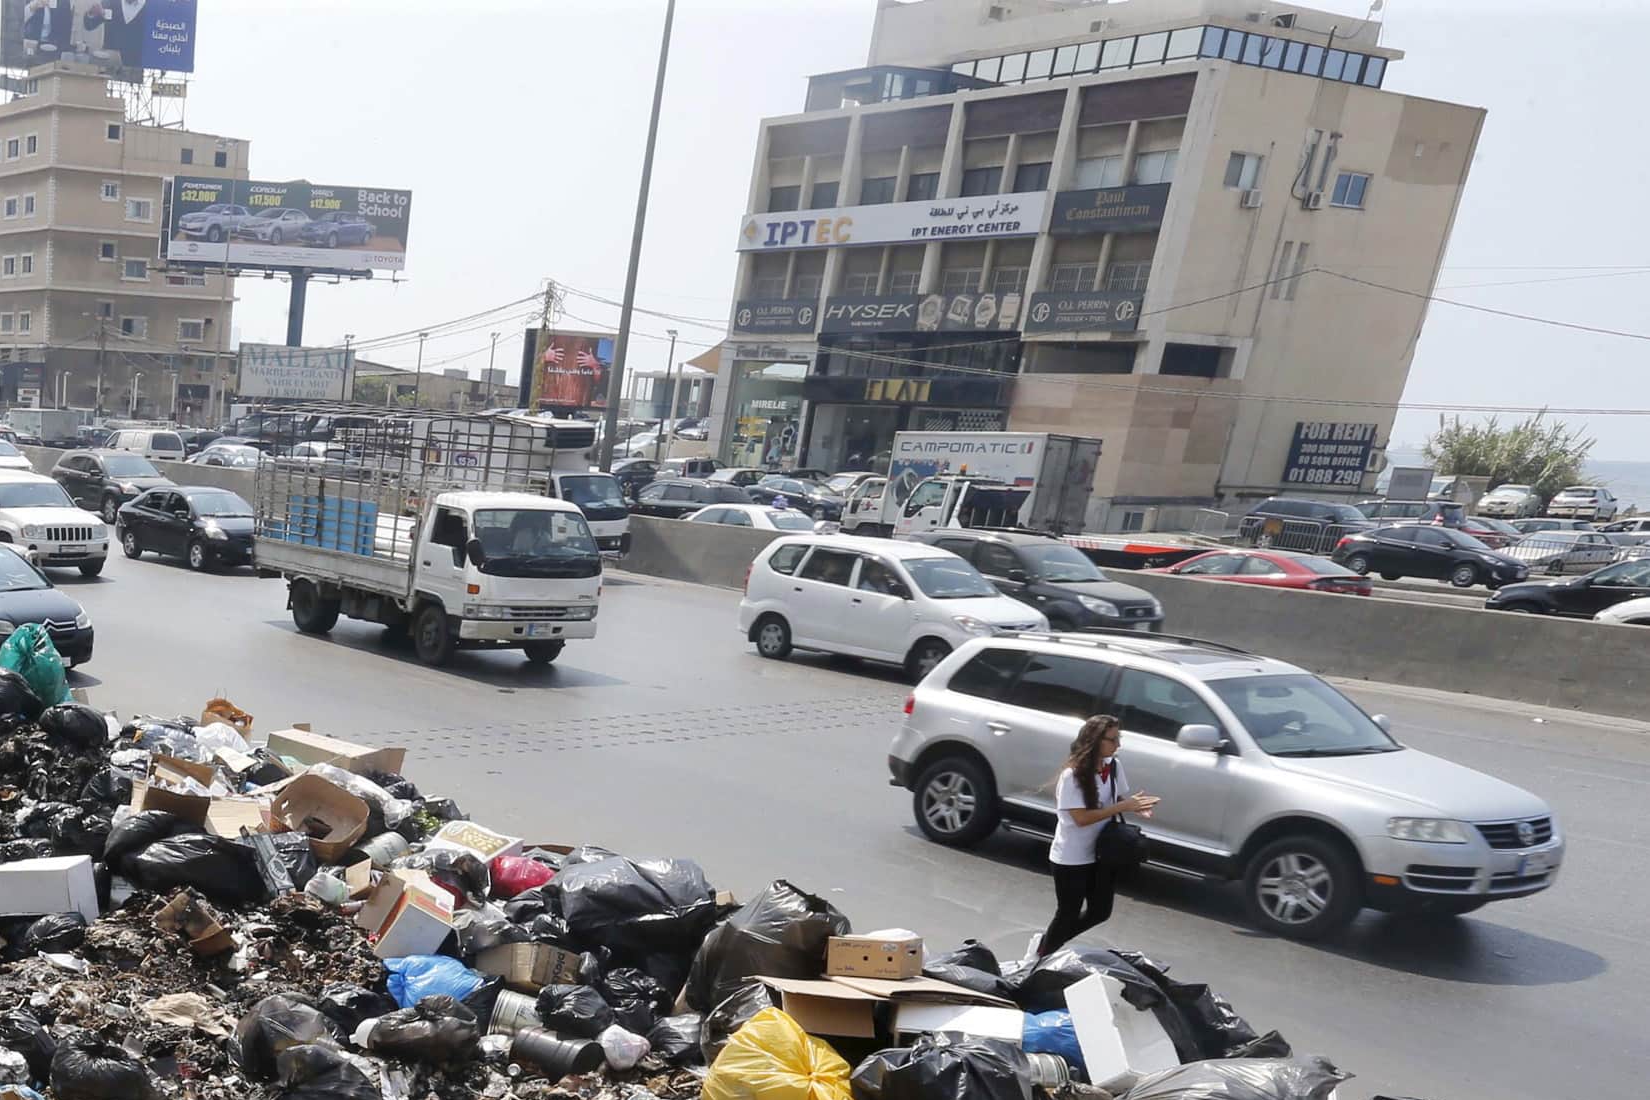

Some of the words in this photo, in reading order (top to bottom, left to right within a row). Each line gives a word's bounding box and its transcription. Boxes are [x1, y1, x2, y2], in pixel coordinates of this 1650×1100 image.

[357, 189, 390, 204] Back
[393, 191, 408, 205] to
[357, 202, 404, 219] School
[763, 217, 854, 247] IPTEC
[911, 226, 929, 238] IPT
[930, 223, 974, 236] ENERGY
[976, 221, 1021, 233] CENTER
[373, 255, 404, 264] TOYOTA
[825, 303, 914, 319] HYSEK
[1077, 299, 1111, 311] PERRIN
[751, 399, 788, 410] MIRELIE
[1299, 423, 1331, 440] FOR
[1332, 424, 1375, 441] RENT
[900, 441, 1018, 454] CAMPOMATIC
[1318, 444, 1337, 455] SQM
[1337, 445, 1364, 456] DEPOT
[1310, 456, 1331, 467] SQM
[1331, 457, 1362, 467] OFFICE
[1289, 467, 1307, 482] 01
